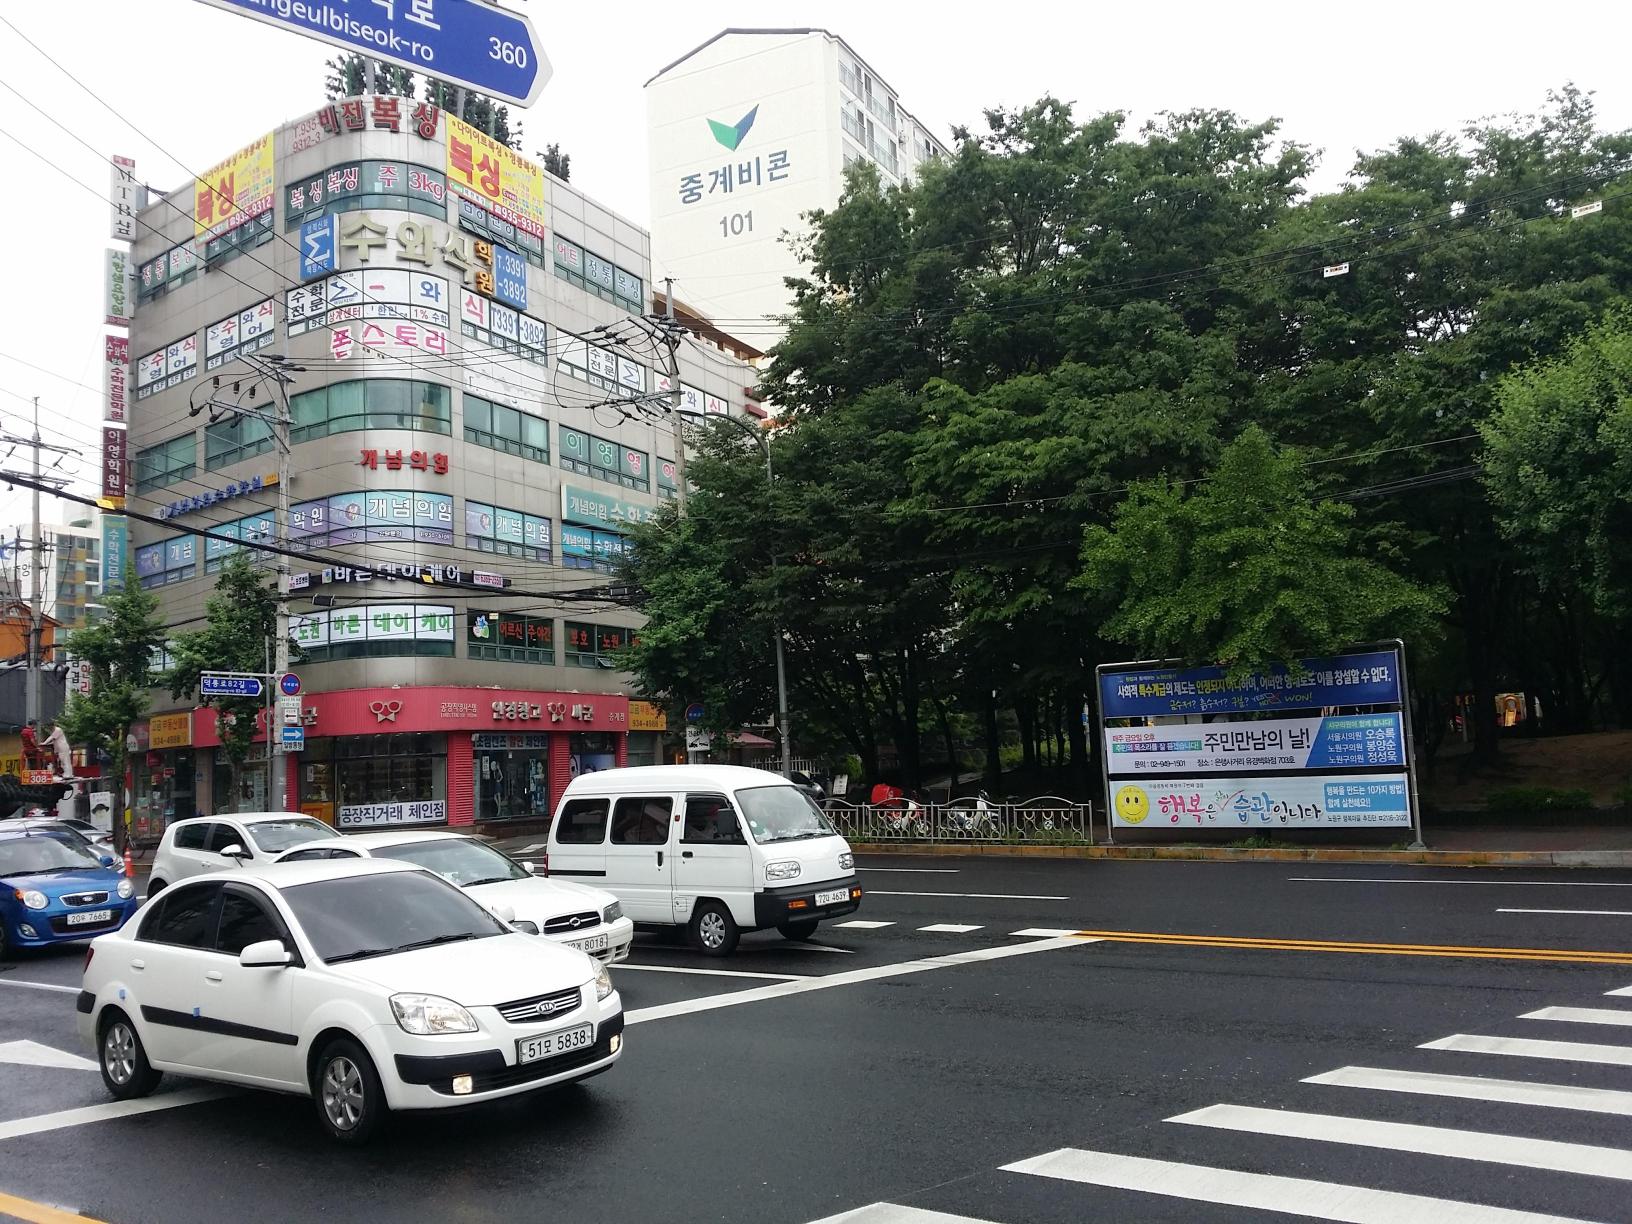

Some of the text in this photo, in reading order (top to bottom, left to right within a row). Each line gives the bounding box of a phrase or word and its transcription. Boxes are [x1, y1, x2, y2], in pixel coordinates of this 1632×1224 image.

[488, 37, 527, 68] 360
[450, 134, 500, 197] 복싱
[679, 150, 790, 204] 중계비콘
[196, 171, 235, 224] 복싱
[291, 178, 323, 208] 복싱
[327, 167, 359, 193] 복싱
[379, 165, 398, 188] 주
[409, 171, 443, 201] 3kg
[234, 196, 272, 225] 935-9312
[501, 206, 543, 236] 935-9312
[720, 210, 753, 238] 101
[290, 283, 324, 303] 수학
[419, 281, 441, 303] 와
[498, 279, 526, 304] -3892
[432, 312, 448, 325] 수학
[332, 324, 447, 360] 폰스토리
[360, 449, 449, 475] 개념의힘
[368, 497, 452, 522] 개념의힘
[570, 496, 607, 520] 개념의힘
[497, 514, 550, 543] 개념의힘
[562, 532, 591, 550] 개념의힘
[500, 621, 523, 639] 어르신
[1118, 684, 1138, 698] 사회적
[1139, 682, 1173, 697] 특수계급의
[1174, 680, 1196, 695] 제도는
[1317, 671, 1334, 687] 이를
[1334, 668, 1360, 685] 창설할
[1360, 670, 1370, 683] 수
[1370, 666, 1392, 683] 없다.
[491, 700, 543, 720] 안경창고
[1143, 733, 1155, 741] 오후
[1204, 727, 1311, 753] 주민만남의 날!
[1327, 727, 1396, 742] 서울시의원 오승록
[1328, 739, 1398, 753] 노원구의원 봉양순
[1328, 750, 1398, 764] 노원구의원 정성욱
[1327, 785, 1345, 796] 행복을
[1346, 785, 1366, 796] 만드는
[1368, 785, 1388, 796] 10가지
[341, 801, 444, 824] 공장직거래 체인점
[1158, 791, 1322, 824] 행복은 습관입니다
[584, 937, 604, 950] 8018
[539, 1002, 554, 1011] KIA
[557, 1029, 587, 1050] 5838
